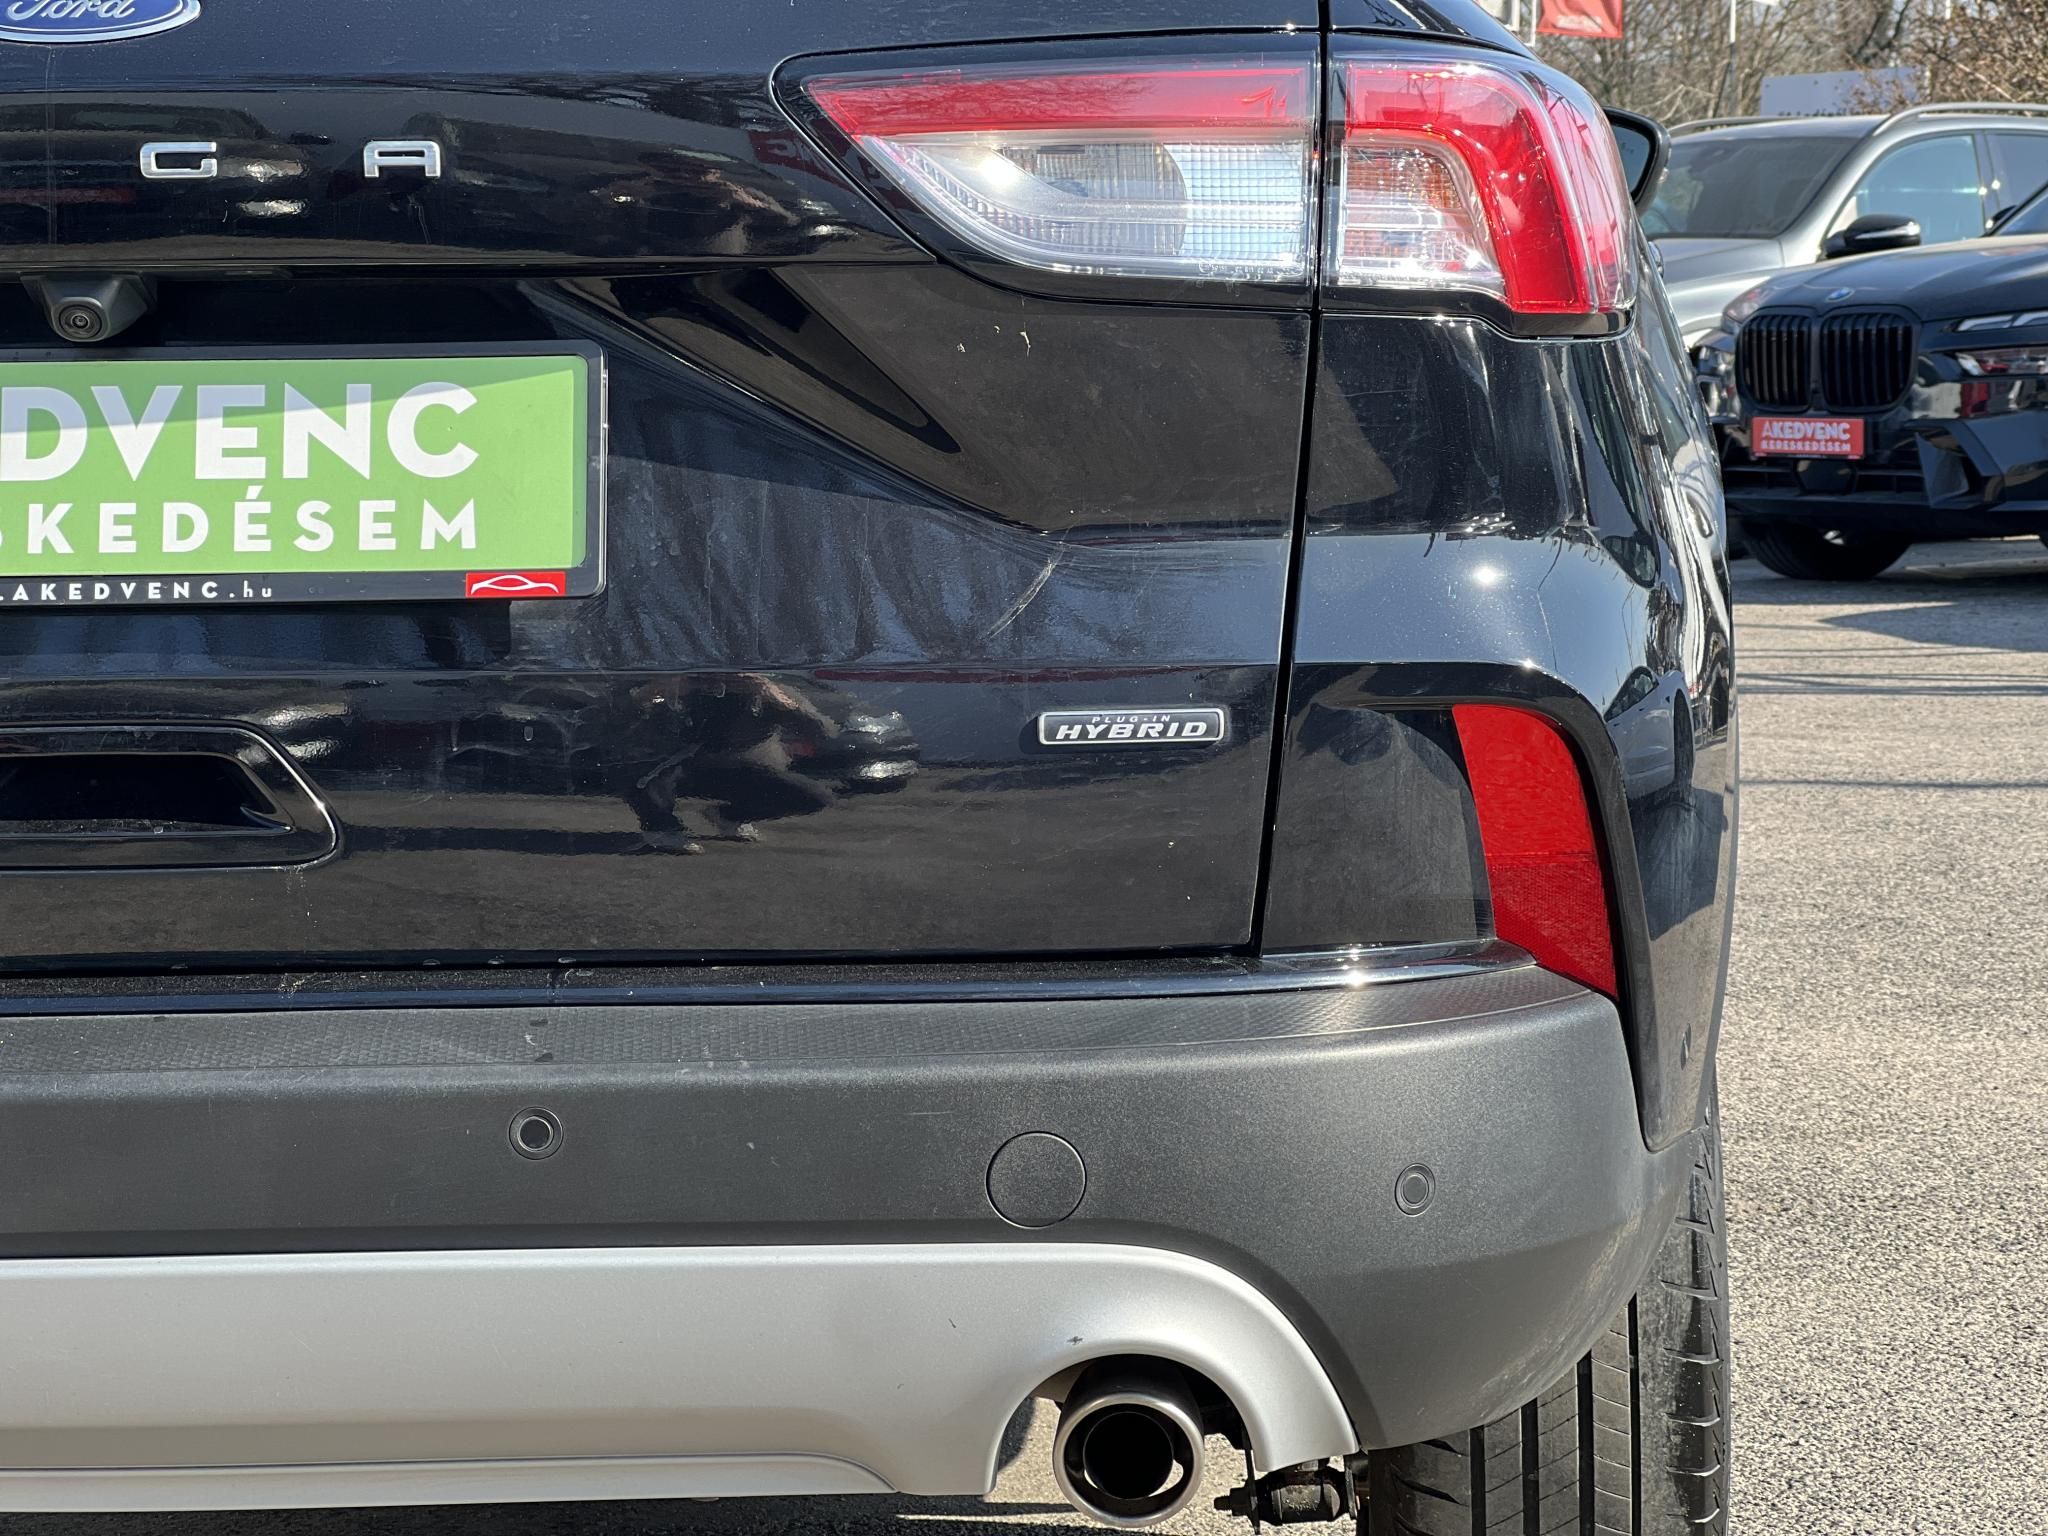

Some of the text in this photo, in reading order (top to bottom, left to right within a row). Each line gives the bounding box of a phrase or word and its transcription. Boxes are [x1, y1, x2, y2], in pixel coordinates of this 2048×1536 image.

[1762, 421, 1850, 440] AKEDVENC
[0, 485, 477, 555] KEDÉSEM
[1091, 714, 1171, 724] PLUG-IN
[1055, 721, 1208, 740] HYBRID
